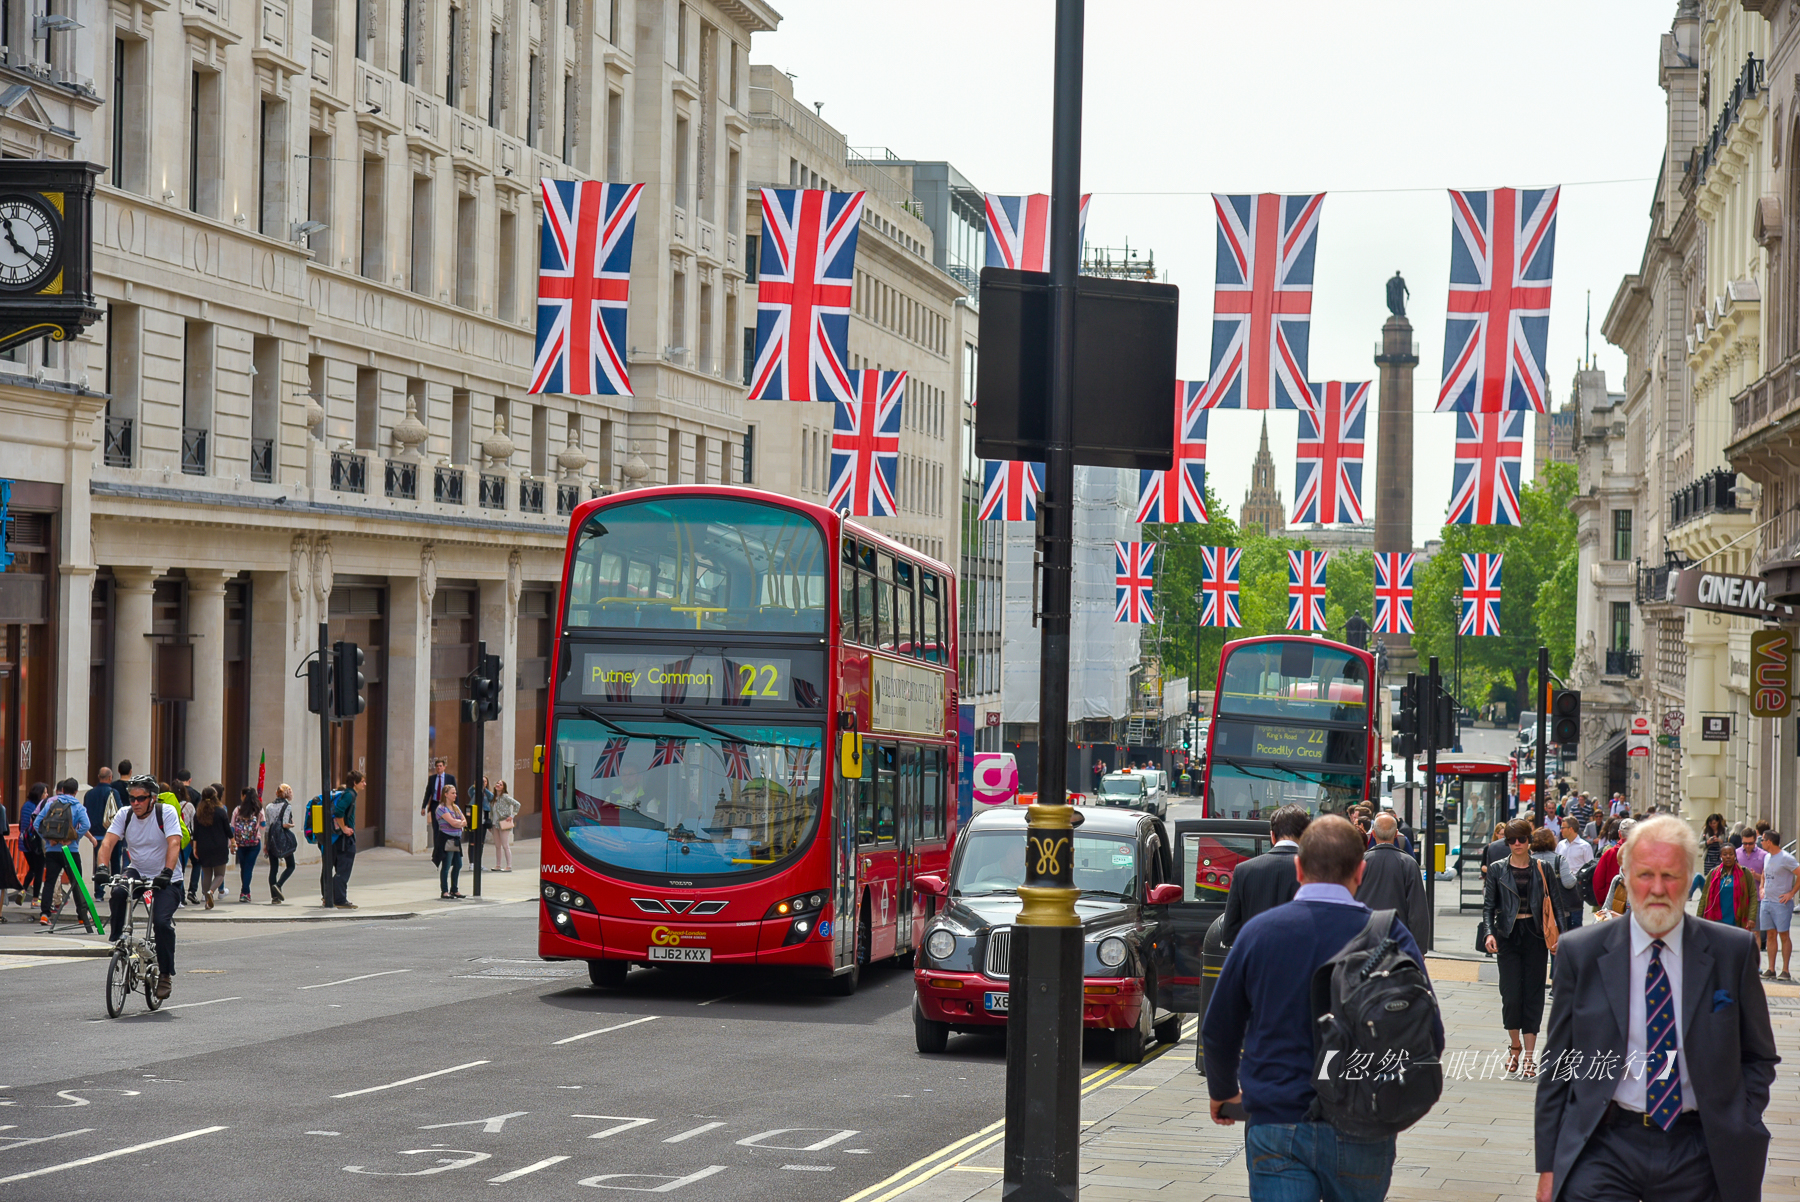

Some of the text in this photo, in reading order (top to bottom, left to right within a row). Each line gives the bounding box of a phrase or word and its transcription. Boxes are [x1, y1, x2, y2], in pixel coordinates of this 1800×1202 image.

[1704, 612, 1722, 625] 15
[591, 666, 713, 688] Putney Common
[739, 664, 779, 696] 22
[1666, 712, 1684, 721] COSTA
[1266, 732, 1283, 741] King's
[1307, 729, 1324, 744] 22
[1257, 743, 1322, 758] Piccadilly Circus
[541, 864, 575, 874] WVL496
[651, 925, 680, 946] Go
[653, 948, 706, 961] LJ62 KXX
